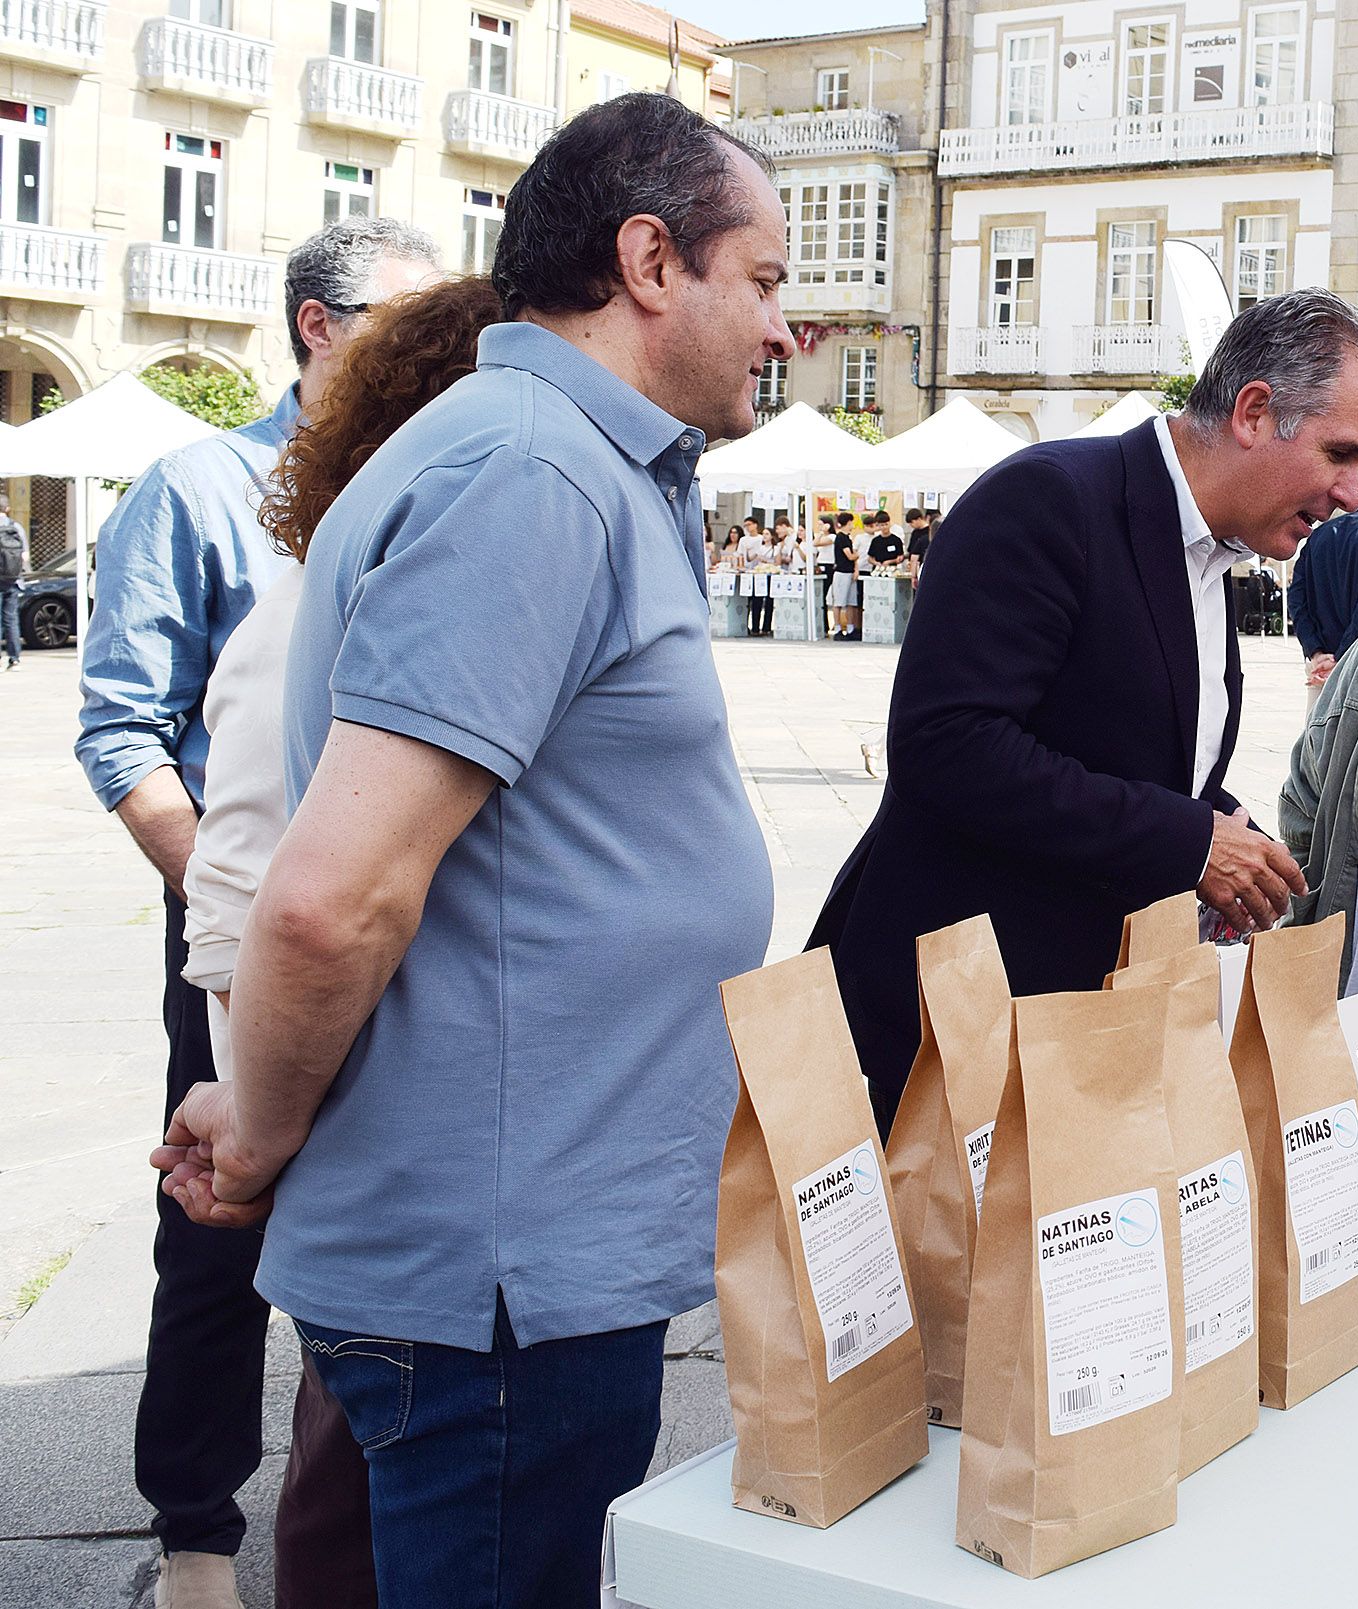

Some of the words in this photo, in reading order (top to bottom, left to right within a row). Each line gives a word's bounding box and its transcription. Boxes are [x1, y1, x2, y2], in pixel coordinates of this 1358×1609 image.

[968, 1131, 994, 1157] XIRIT
[798, 1165, 852, 1207] NATIÑAS
[1179, 1172, 1218, 1203] RITAS
[800, 1207, 812, 1222] DE
[813, 1182, 855, 1215] SANTIAGO
[1041, 1210, 1112, 1243] NATIÑAS
[1042, 1246, 1056, 1260] DE
[1057, 1229, 1114, 1255] SANTIAGO
[841, 1311, 853, 1327] 250
[1077, 1367, 1090, 1380] 250
